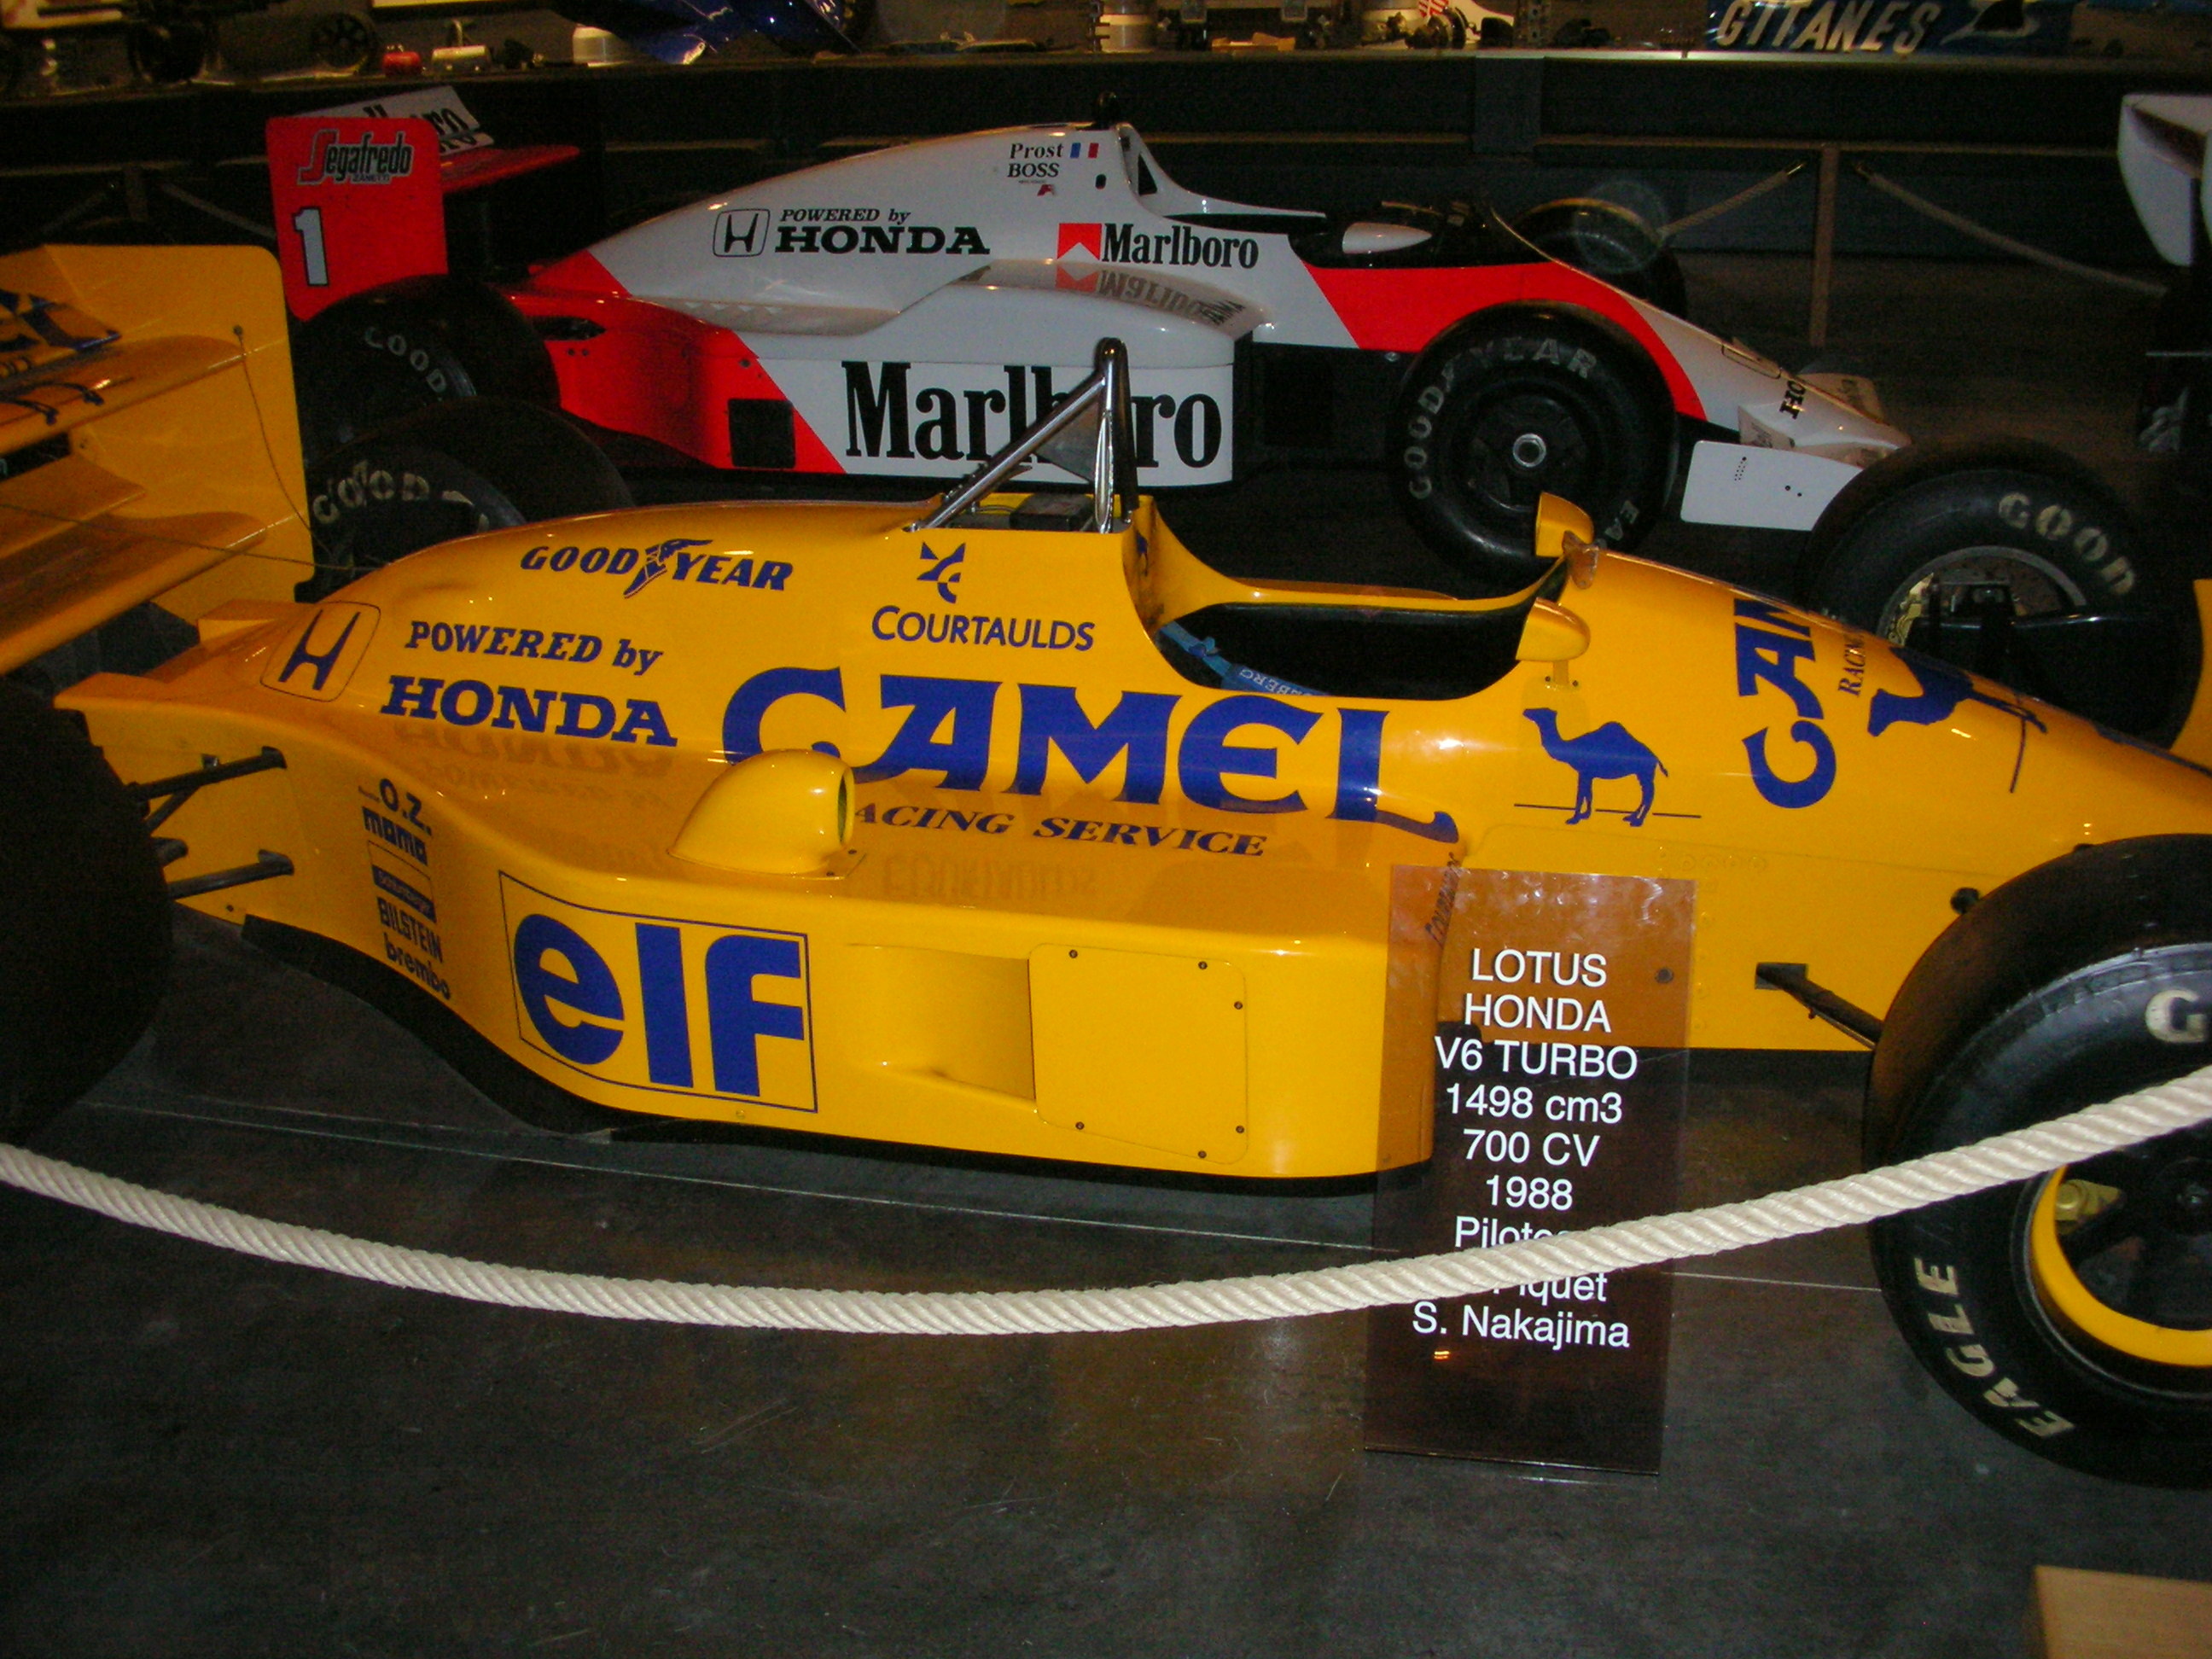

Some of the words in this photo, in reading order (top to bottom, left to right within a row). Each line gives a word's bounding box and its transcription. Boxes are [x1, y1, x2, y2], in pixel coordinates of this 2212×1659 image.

[1715, 0, 1941, 53] GITANES
[298, 128, 414, 184] Segafredo
[1007, 162, 1060, 178] BOSS
[1010, 143, 1064, 159] Prost
[774, 225, 991, 255] HONDA
[779, 209, 881, 223] POWERED
[888, 208, 911, 225] by
[291, 207, 329, 287] 1
[1101, 223, 1259, 269] Marlboro
[841, 360, 1222, 469] Marlro
[520, 546, 639, 575] GOOD
[671, 550, 794, 591] YEAR
[405, 621, 601, 662] POWERED
[612, 639, 663, 675] by
[871, 605, 1095, 652] COURTAULDS
[381, 675, 678, 748] HONDA
[722, 666, 1460, 845] CAMEL
[854, 800, 1014, 836] ACING
[1033, 816, 1267, 857] SERVICE
[376, 896, 444, 964] BILSTEIN
[383, 932, 451, 1001] brembo
[1471, 948, 1608, 988] LOTUS
[514, 913, 805, 1097] elf
[1464, 992, 1612, 1033] HONDA
[1434, 1035, 1484, 1072] V6
[1494, 1039, 1639, 1080] TURBO
[1446, 1082, 1534, 1121] 1498
[1545, 1091, 1623, 1125] cm3
[1463, 1128, 1530, 1164] 700
[1542, 1132, 1601, 1167] CV
[1486, 1174, 1574, 1212] 1988
[1412, 1301, 1447, 1335] S.
[1461, 1304, 1631, 1352] Nakajima
[1913, 1257, 2075, 1439] EAGLE
